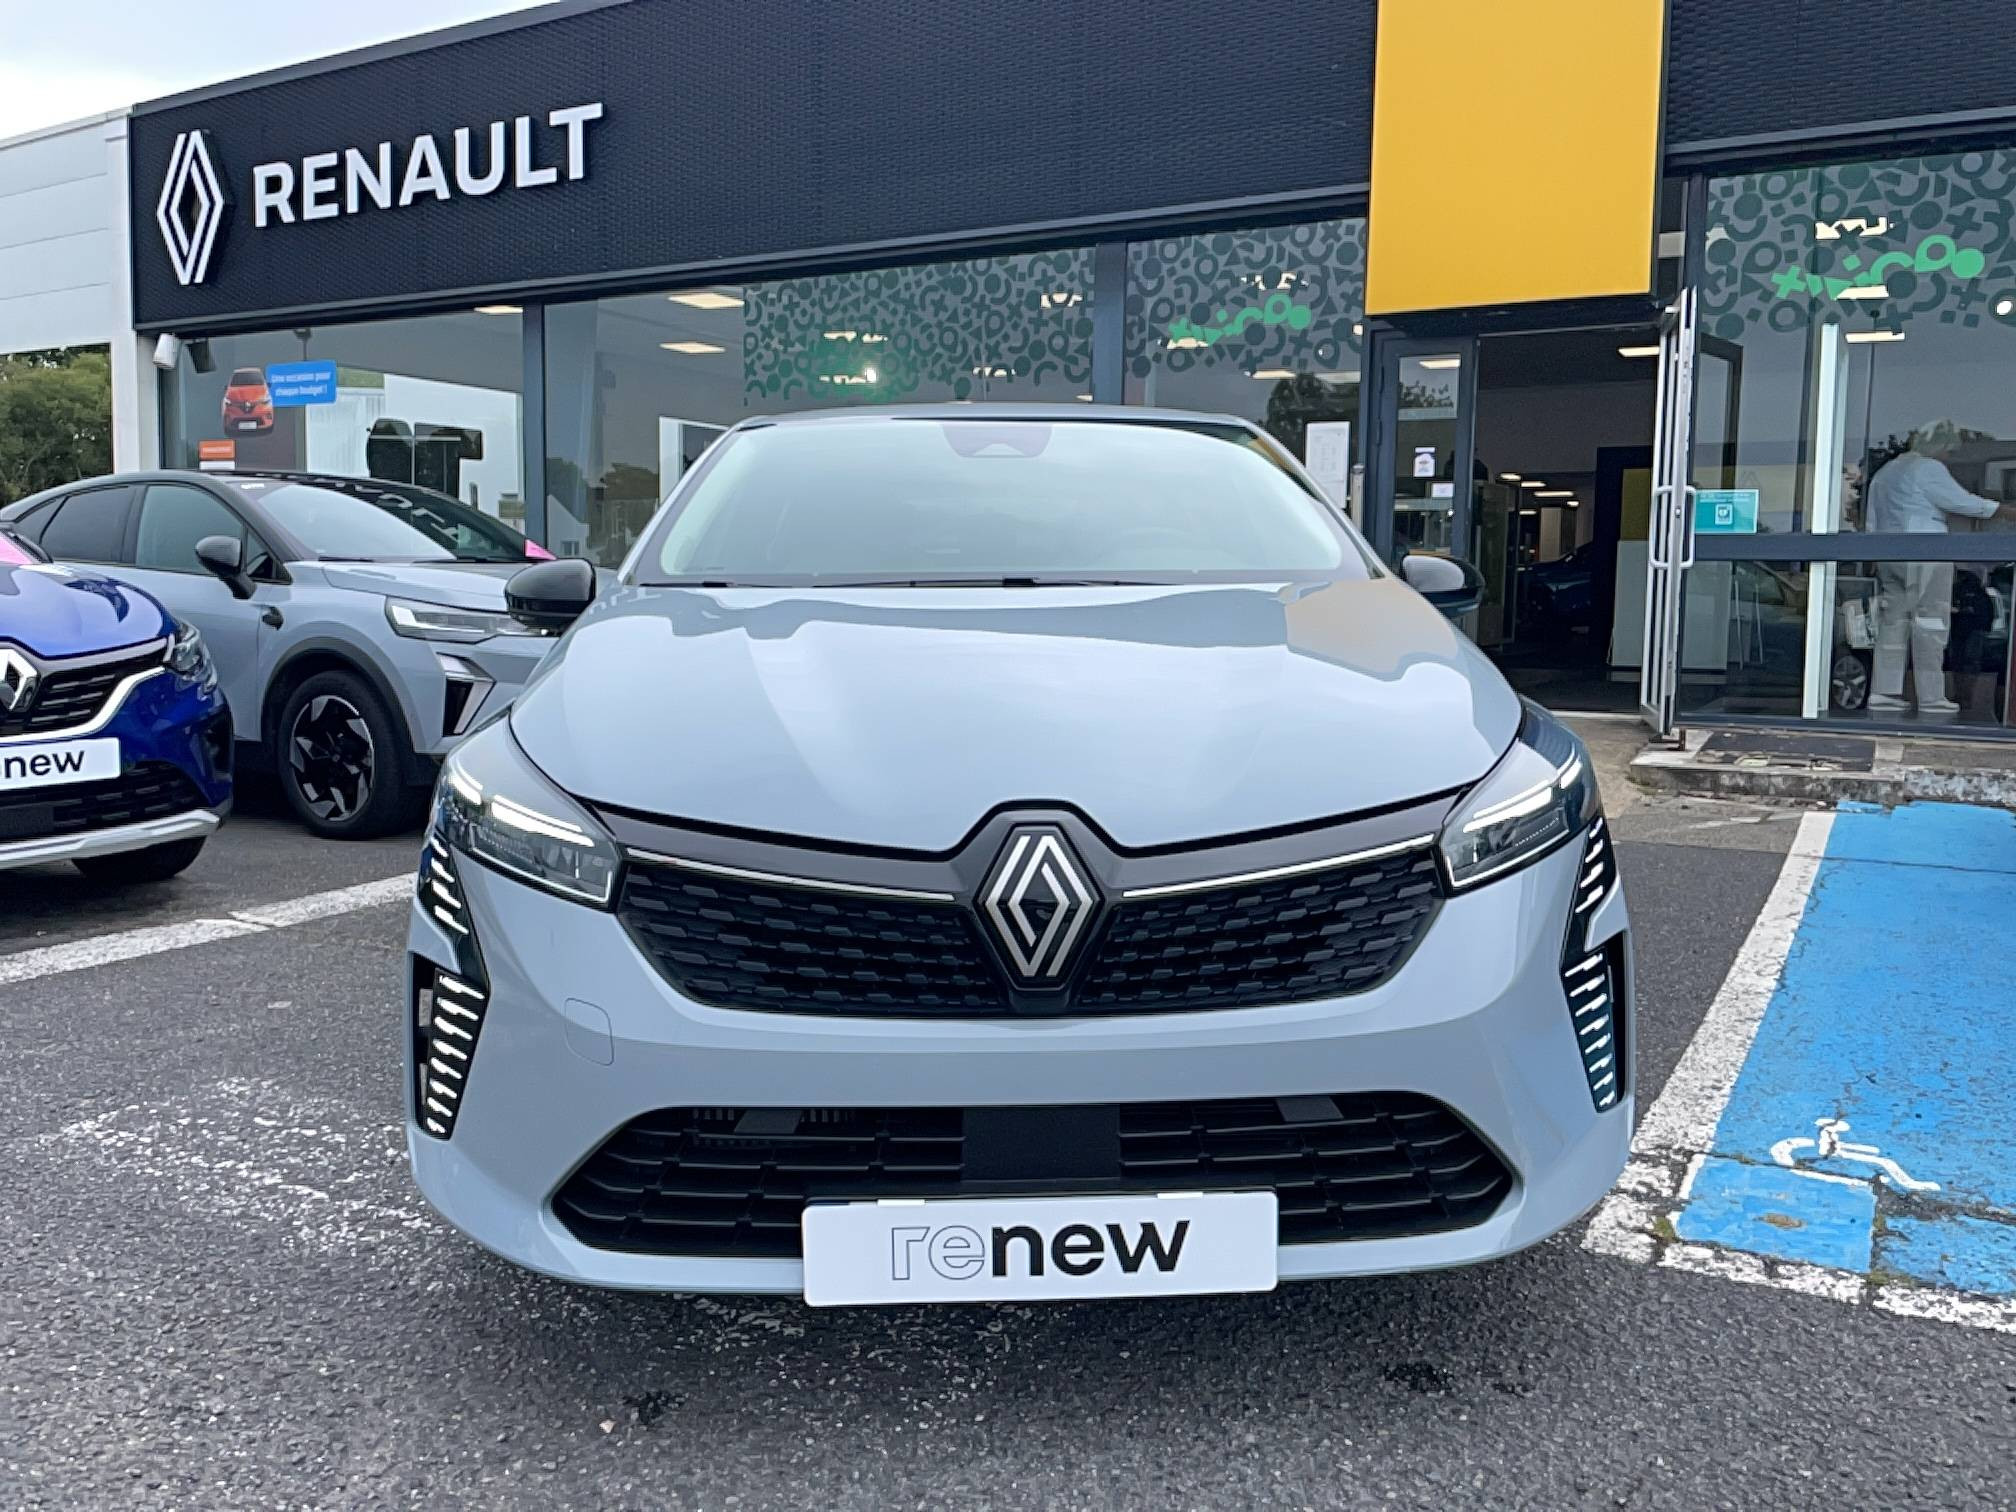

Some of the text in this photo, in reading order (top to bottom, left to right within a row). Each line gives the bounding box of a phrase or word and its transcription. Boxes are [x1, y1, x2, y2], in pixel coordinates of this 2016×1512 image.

[253, 102, 603, 227] RENAULT
[0, 750, 85, 779] new
[891, 1220, 1190, 1280] renew
